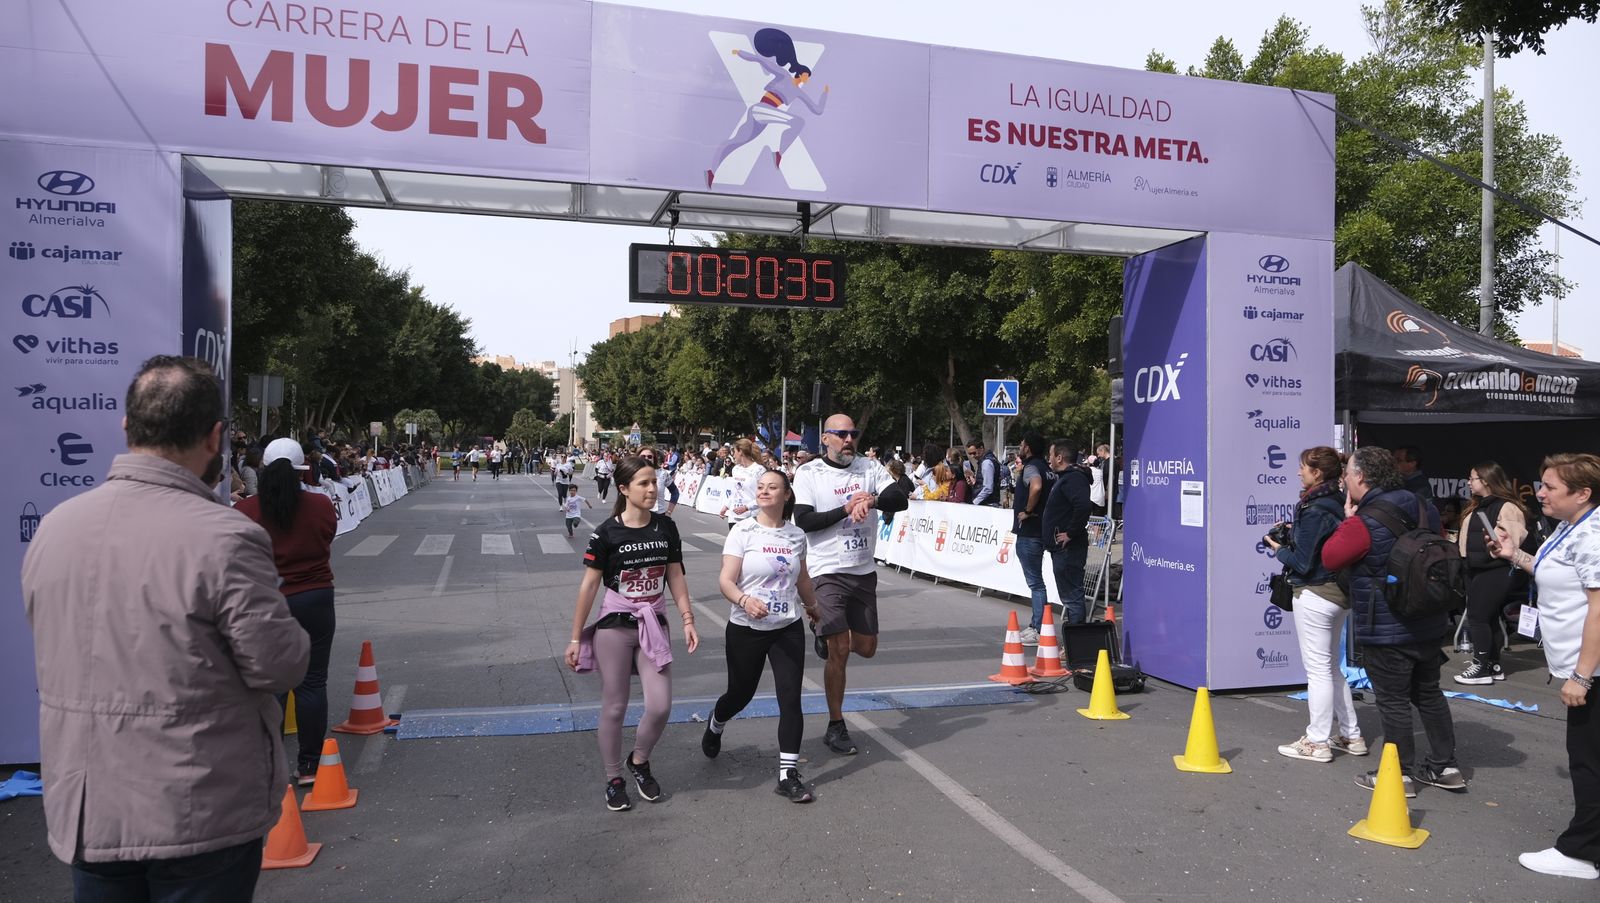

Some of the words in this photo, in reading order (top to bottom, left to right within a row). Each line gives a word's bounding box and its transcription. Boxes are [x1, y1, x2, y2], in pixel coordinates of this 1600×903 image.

[226, 0, 412, 45] CARRERA
[425, 20, 471, 50] DE
[486, 25, 529, 57] LA
[204, 42, 547, 144] MUJER
[1010, 82, 1040, 108] LA
[1048, 87, 1172, 122] IGUALDAD
[967, 118, 1001, 143] ES
[1007, 121, 1129, 157] NUESTRA
[1134, 136, 1209, 164] META.
[1066, 168, 1112, 184] ALMERÍA
[1066, 181, 1090, 189] CIUDAD
[16, 197, 117, 214] HYUNDAI
[28, 213, 105, 227] Almerialva
[41, 244, 123, 263] cajamar
[667, 252, 835, 302] 00:20:35
[1247, 274, 1301, 286] HYUNDAI
[1253, 286, 1295, 296] Almerialva
[22, 293, 92, 319] CASI
[1260, 308, 1305, 321] cajamar
[46, 337, 119, 355] vithas
[1250, 343, 1288, 362] CASI
[46, 356, 63, 365] vivir
[65, 358, 83, 366] para
[85, 358, 119, 366] cuidarte
[1262, 376, 1302, 389] vithas
[32, 393, 118, 414] aqualia
[1486, 392, 1536, 402] cronometraje
[1537, 394, 1574, 404] deportivo
[1254, 416, 1301, 432] aqualia
[1146, 458, 1195, 475] ALMERÍA
[40, 472, 95, 487] Clece
[1146, 476, 1170, 486] CIUDAD
[1257, 473, 1287, 485] Clece
[834, 483, 861, 496] MUJER
[954, 524, 998, 546] ALMERÍA
[618, 541, 668, 553] COSENTINO
[762, 546, 792, 555] MUJER
[843, 537, 868, 550] 1341
[952, 541, 974, 555] CIUDAD
[626, 578, 659, 593] 2508
